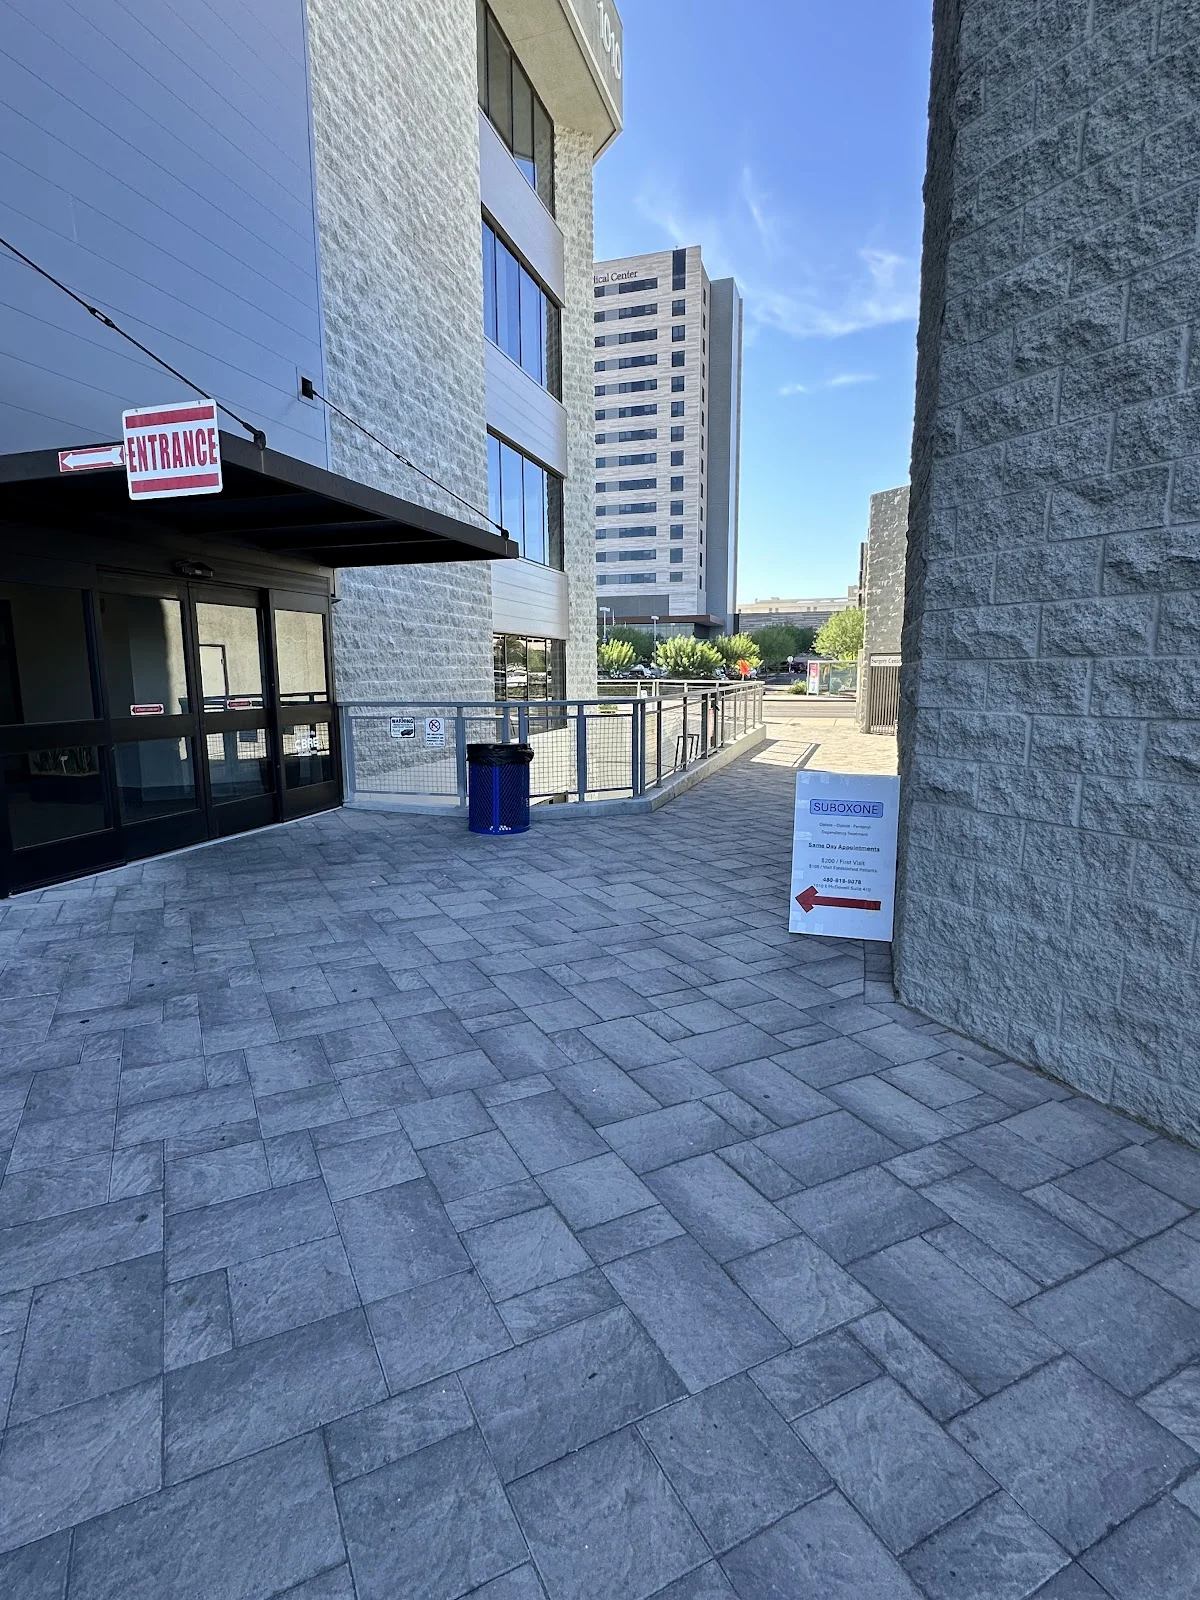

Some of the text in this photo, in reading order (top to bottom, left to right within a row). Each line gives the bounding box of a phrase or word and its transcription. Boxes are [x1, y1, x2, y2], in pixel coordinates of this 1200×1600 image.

[597, 1, 622, 80] 1010
[611, 270, 638, 281] Center
[127, 427, 217, 473] ENTRANCE
[295, 737, 318, 750] CBRE
[813, 802, 879, 814] SUBOXONE
[838, 844, 880, 852] Appointments
